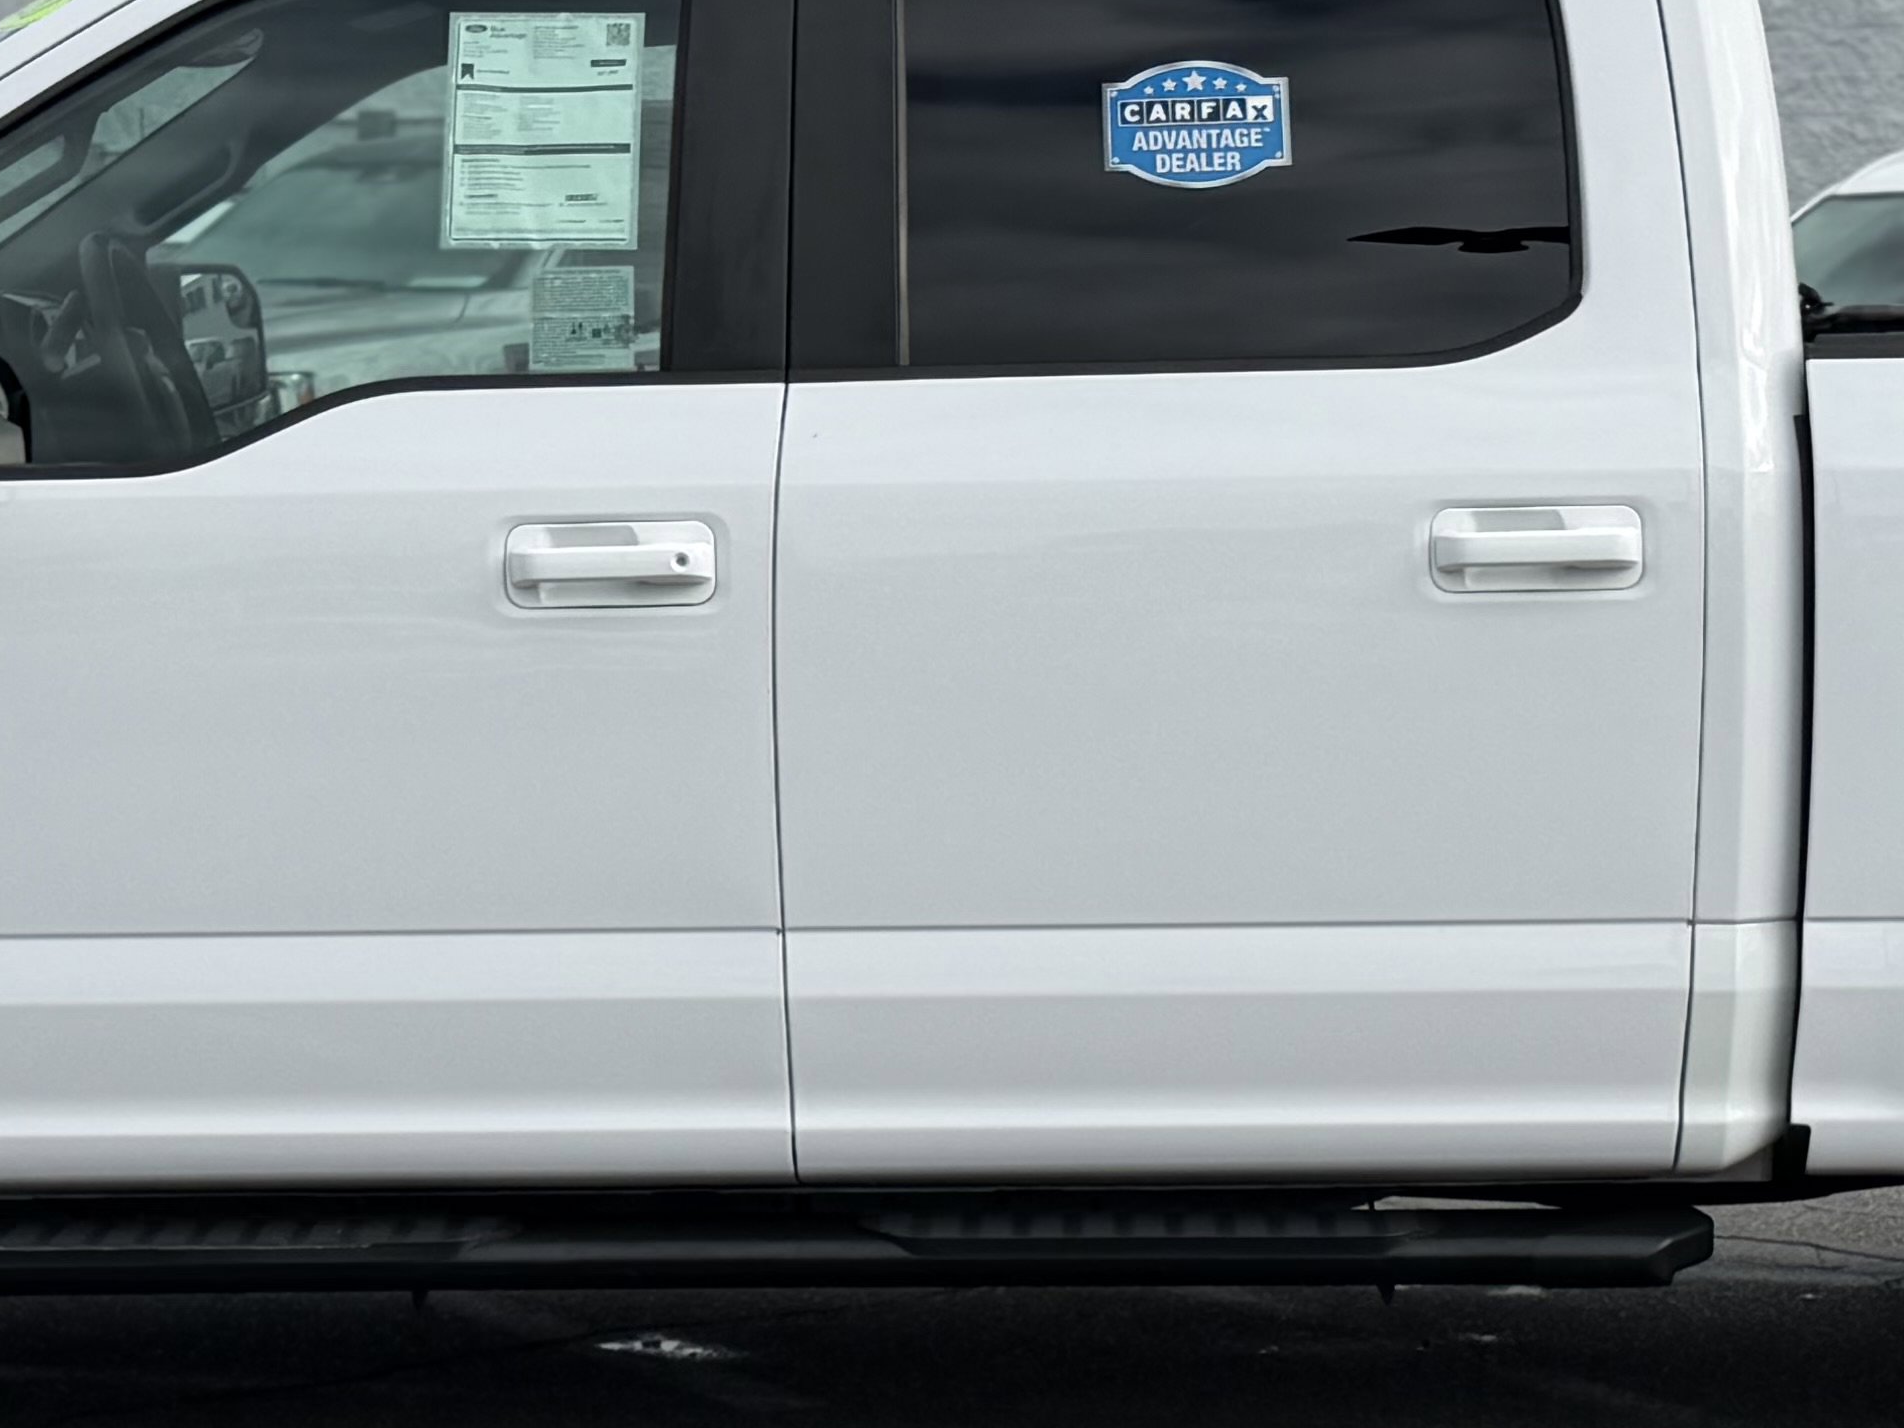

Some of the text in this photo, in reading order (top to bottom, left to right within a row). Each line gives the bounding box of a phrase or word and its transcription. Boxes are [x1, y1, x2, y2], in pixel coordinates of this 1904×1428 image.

[1122, 97, 1269, 123] CARFAX
[1131, 128, 1265, 152] ADVANTAGE
[1154, 151, 1242, 173] DEALER
